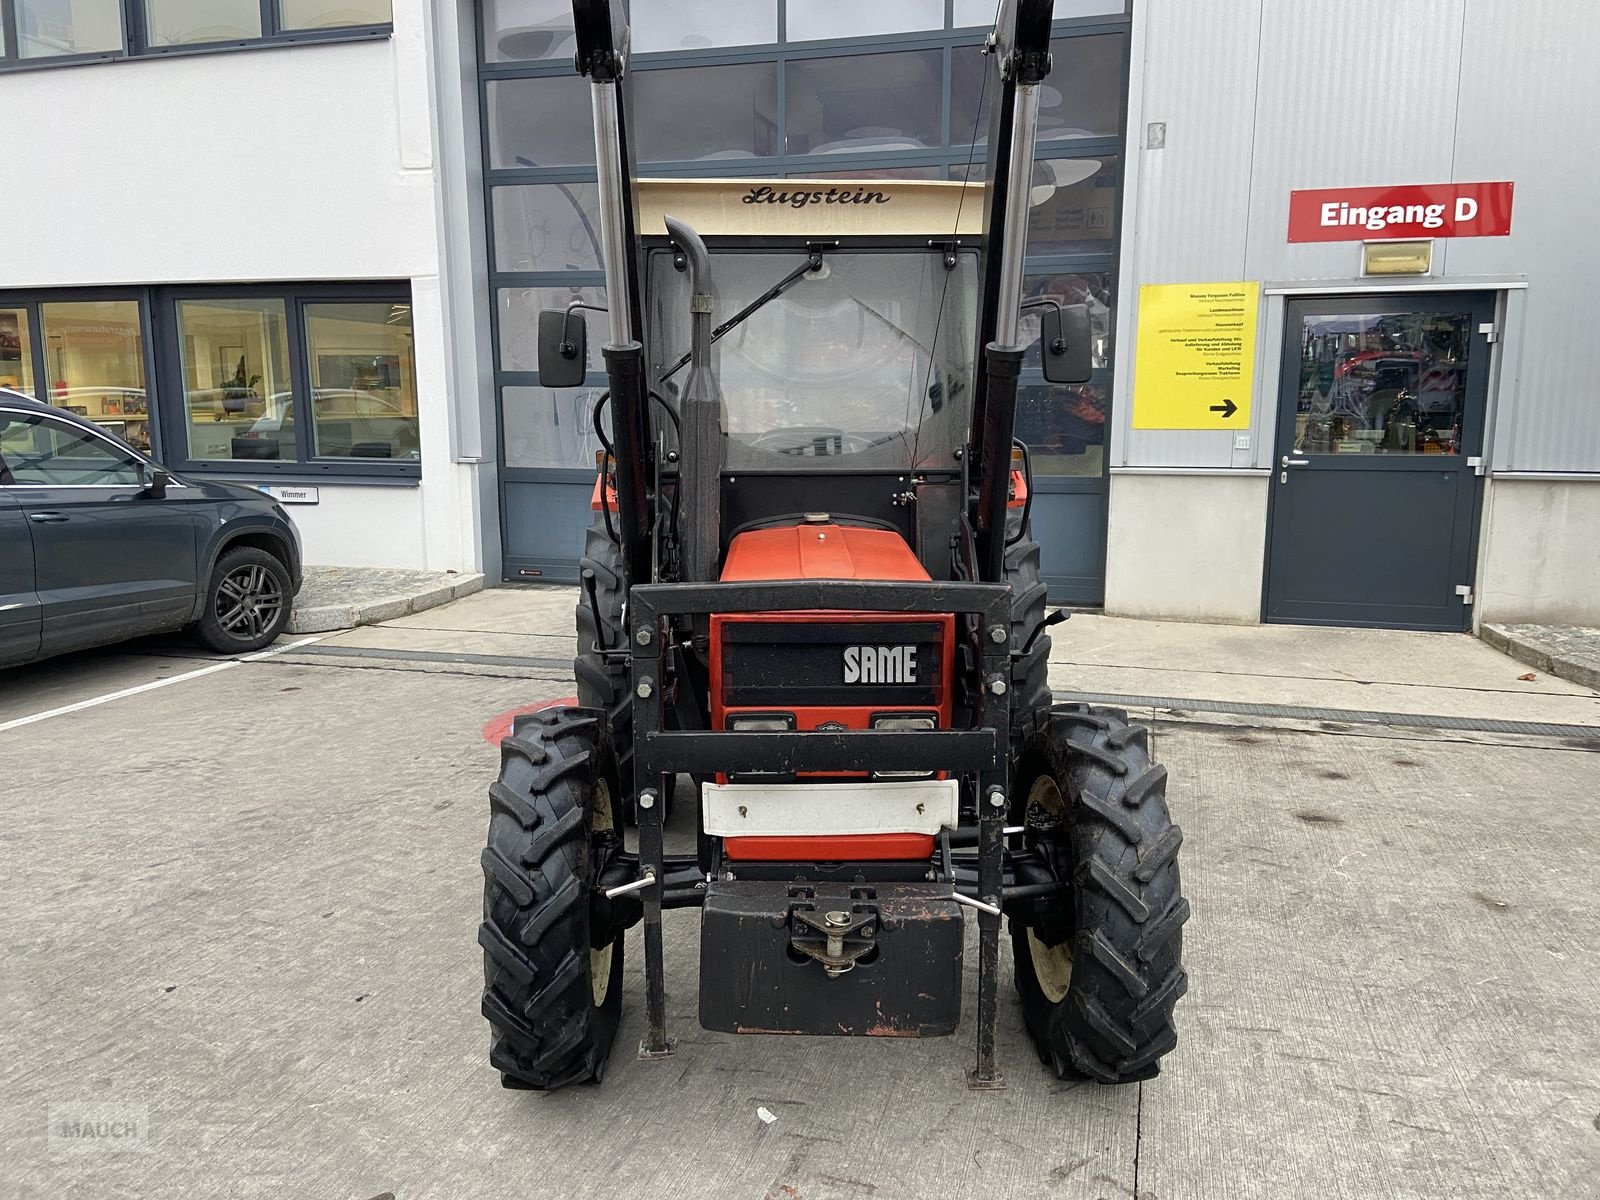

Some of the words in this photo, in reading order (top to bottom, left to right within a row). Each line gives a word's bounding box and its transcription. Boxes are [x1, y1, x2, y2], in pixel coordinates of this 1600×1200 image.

[742, 186, 892, 209] Lugstein
[1321, 200, 1446, 231] Eingang
[1454, 197, 1479, 223] D
[281, 490, 306, 498] Wimmer
[844, 646, 917, 683] SAME
